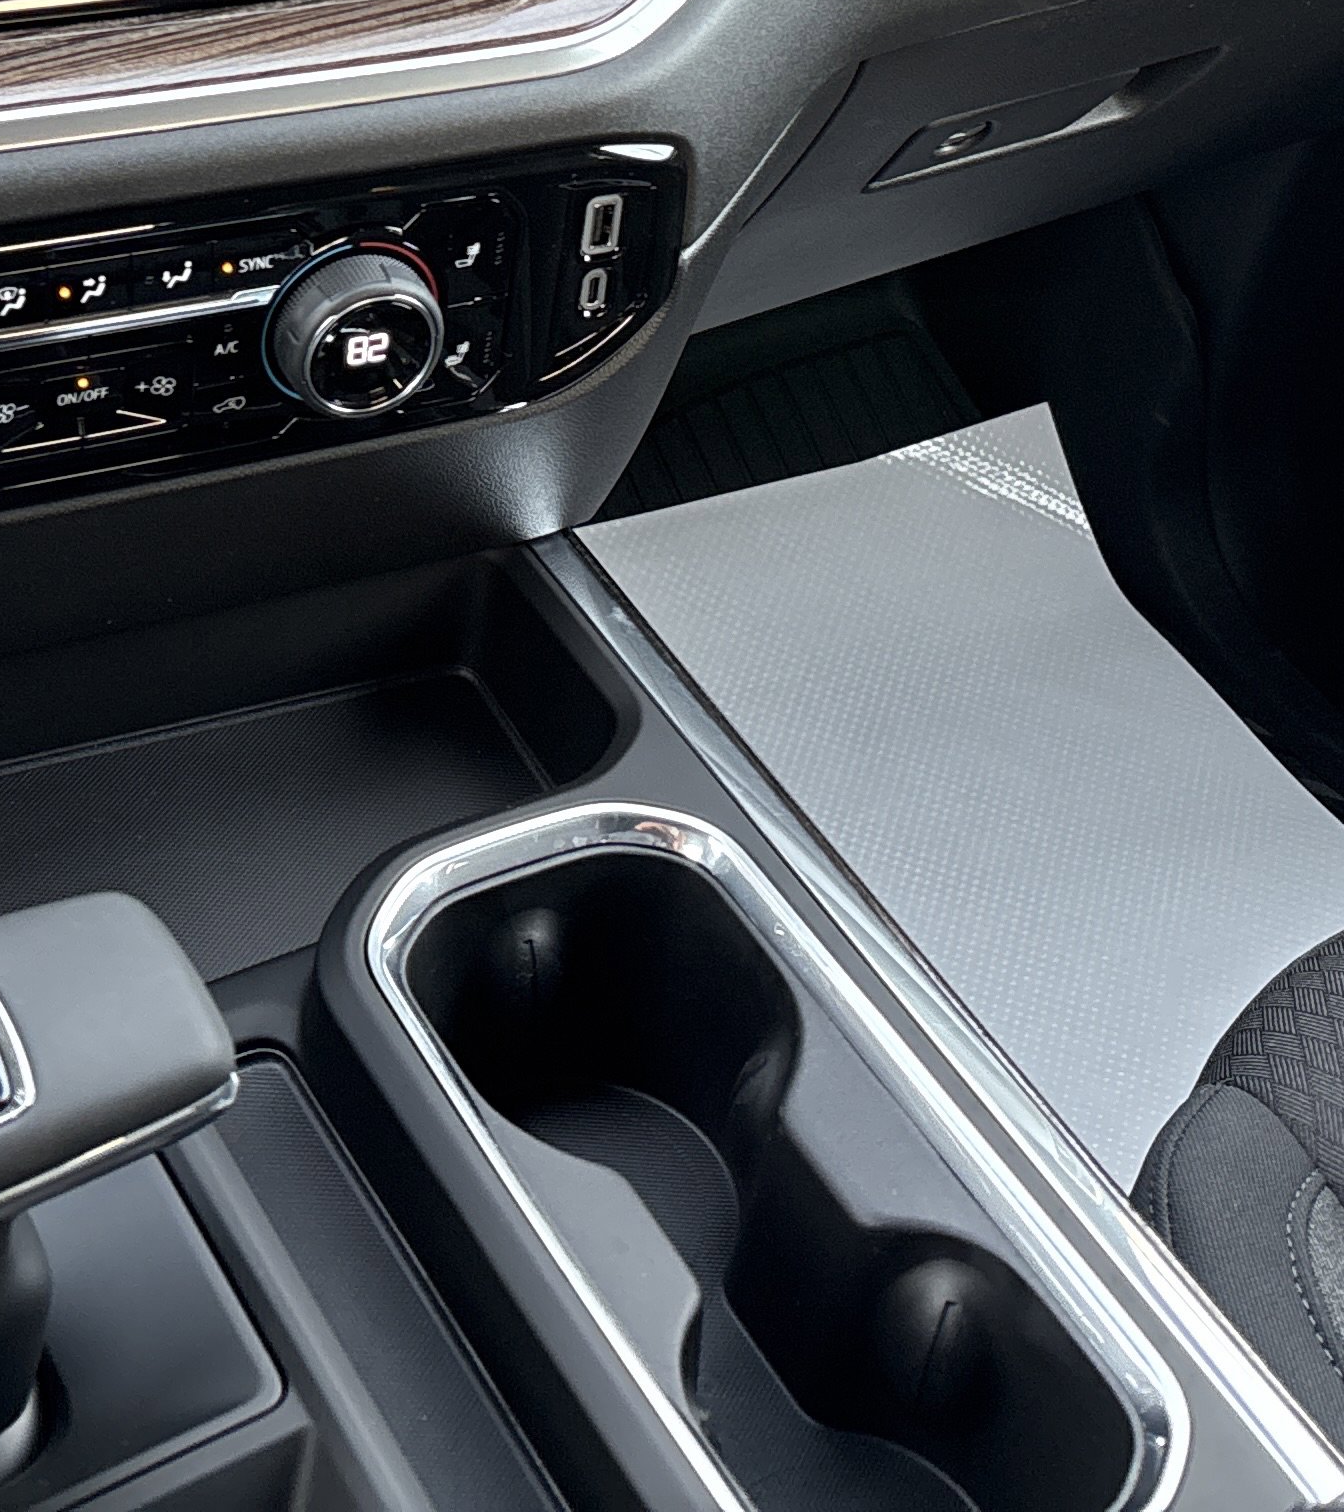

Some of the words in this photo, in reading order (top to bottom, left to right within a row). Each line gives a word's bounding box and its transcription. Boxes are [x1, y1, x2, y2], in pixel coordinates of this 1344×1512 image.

[237, 255, 275, 274] SYNC
[214, 340, 240, 357] A/C
[346, 331, 389, 367] 82
[56, 386, 110, 407] ON/OFF
